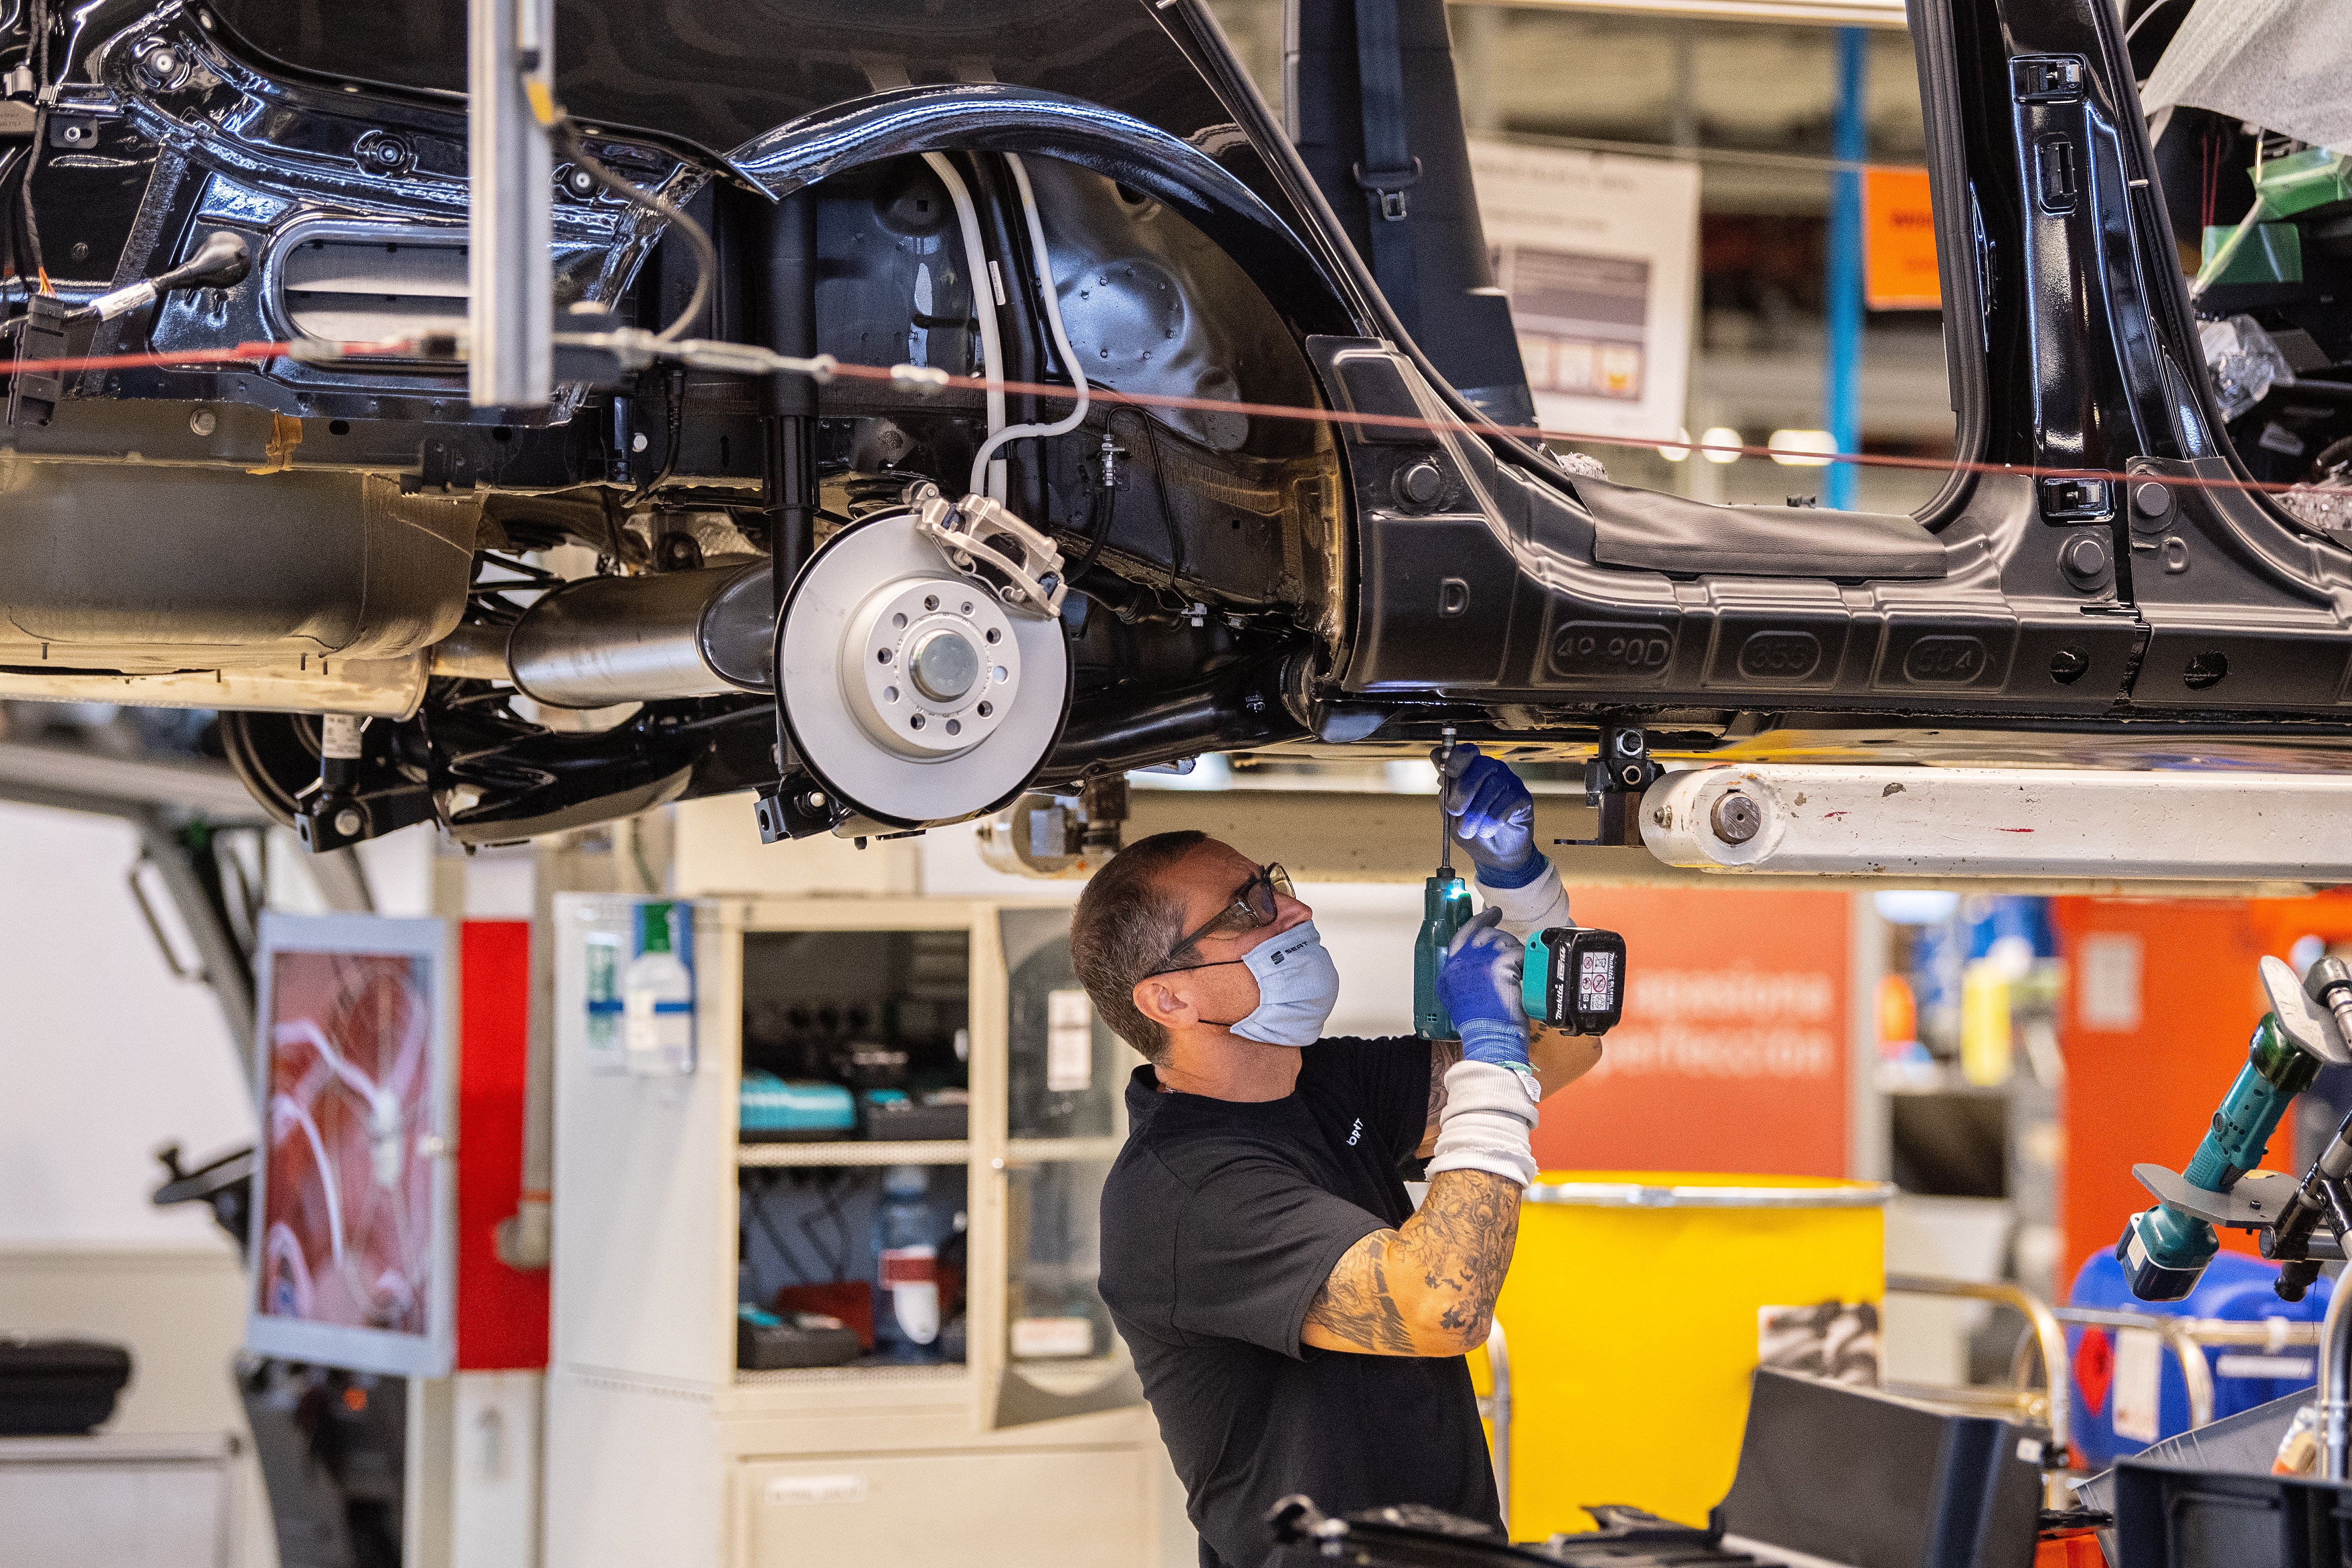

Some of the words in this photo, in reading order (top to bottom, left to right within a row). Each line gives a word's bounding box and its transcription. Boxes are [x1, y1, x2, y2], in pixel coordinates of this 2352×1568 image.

[1438, 577, 1470, 618] D
[1285, 941, 1307, 954] SEAT
[1555, 984, 1564, 1020] makita
